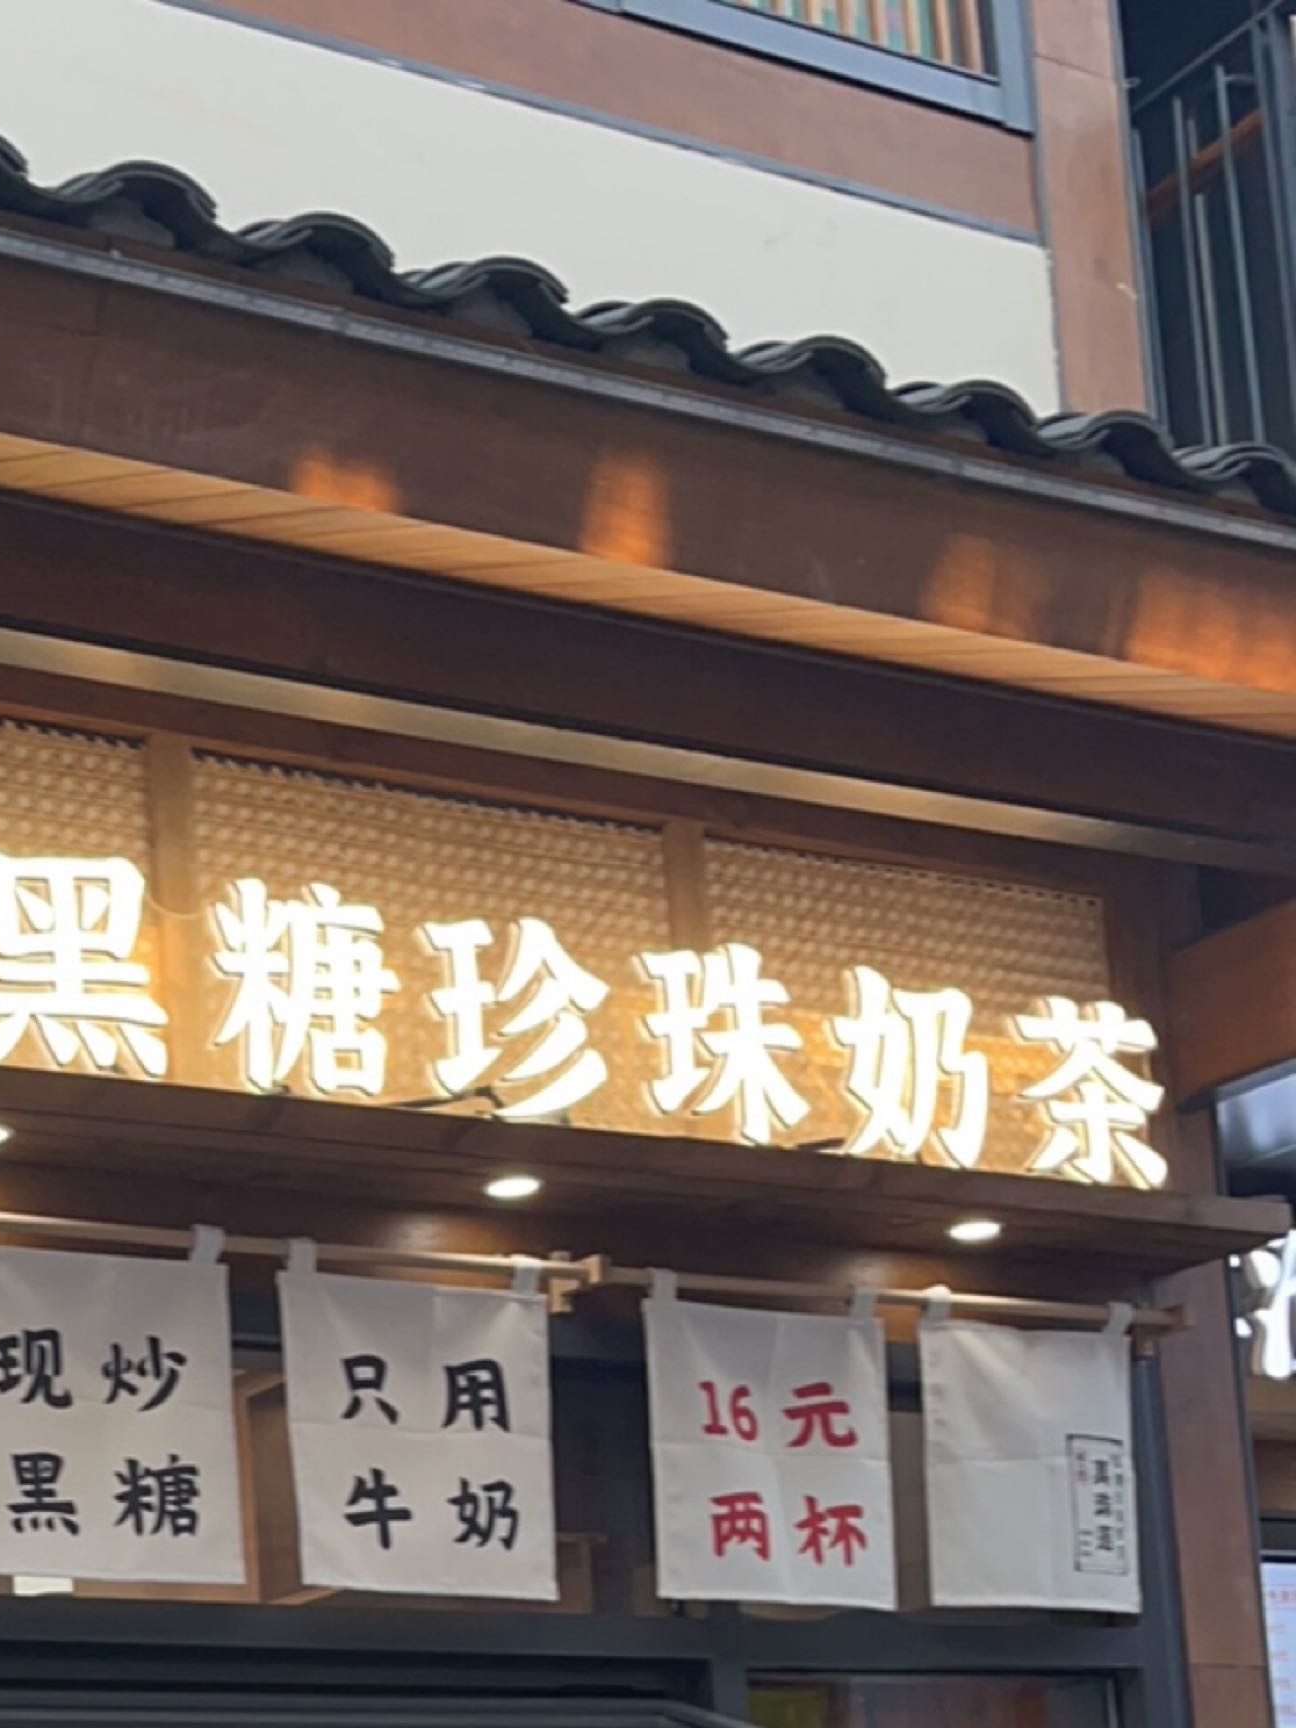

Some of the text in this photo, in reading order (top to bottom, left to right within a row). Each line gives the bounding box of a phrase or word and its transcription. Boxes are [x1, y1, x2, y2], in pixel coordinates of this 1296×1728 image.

[340, 1355, 510, 1433] 只用
[699, 1380, 857, 1448] 16元
[6, 1452, 200, 1537] 黑糖
[344, 1467, 519, 1550] 牛奶
[709, 1491, 868, 1566] 两杯
